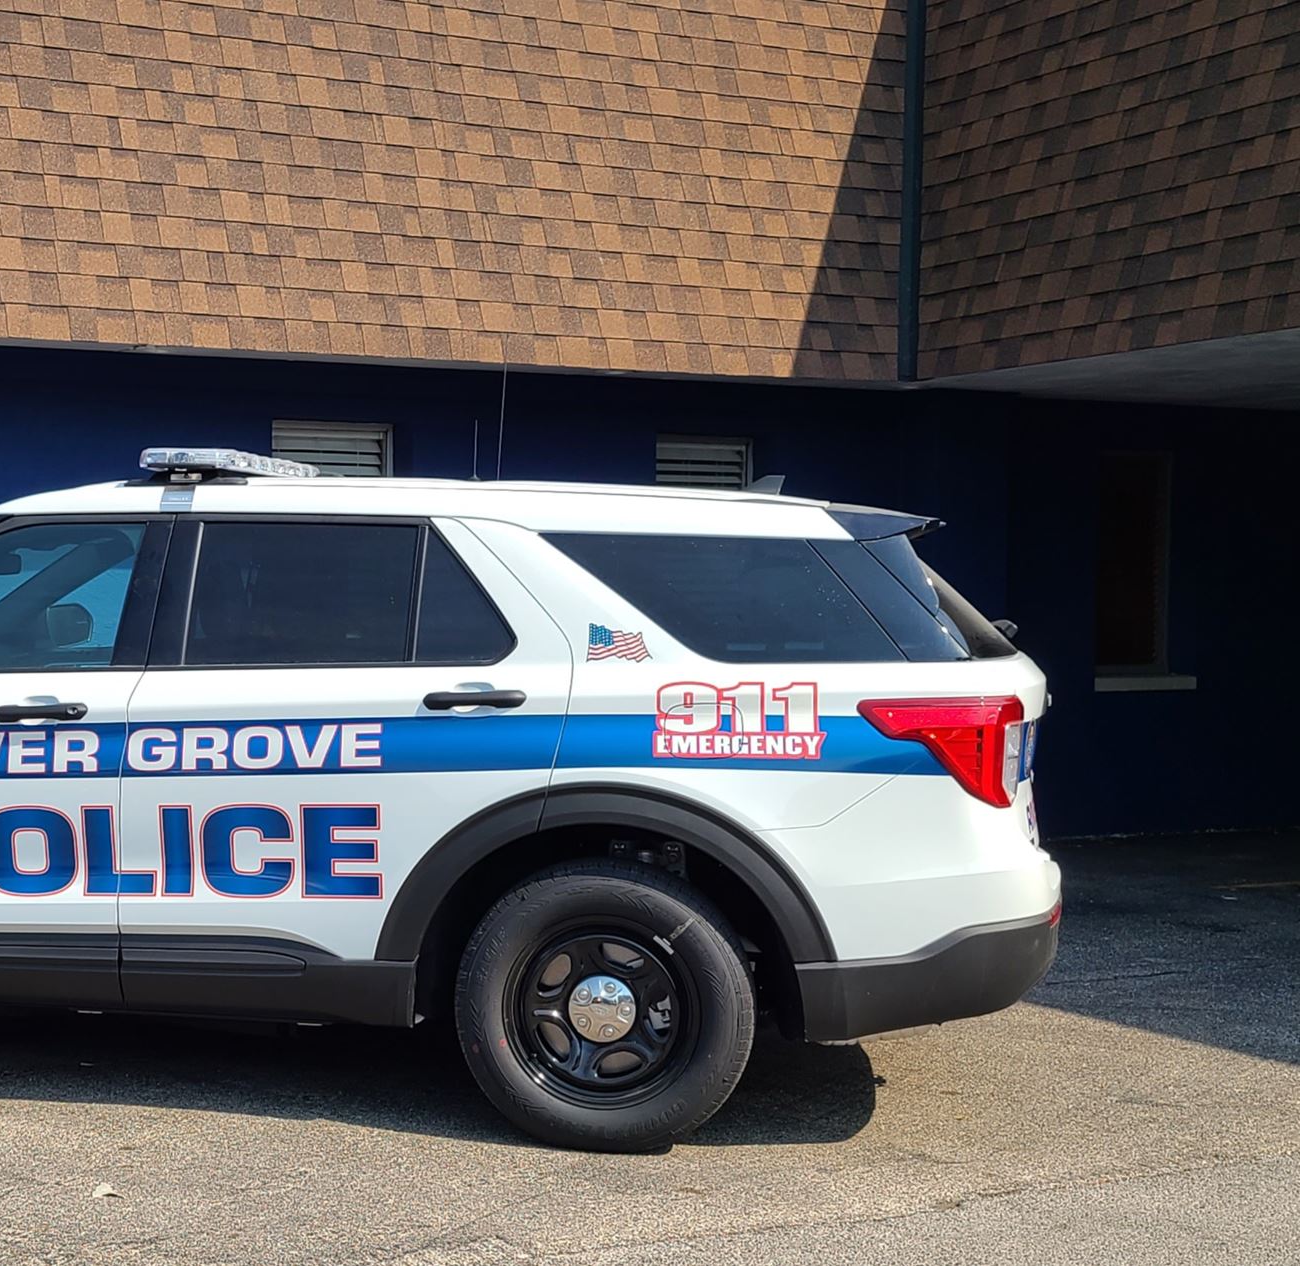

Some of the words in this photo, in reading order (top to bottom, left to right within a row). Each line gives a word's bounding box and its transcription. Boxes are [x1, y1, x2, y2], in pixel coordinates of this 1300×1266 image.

[657, 681, 818, 734] 911
[127, 724, 383, 772] GROVE
[657, 734, 821, 755] EMERGENCY
